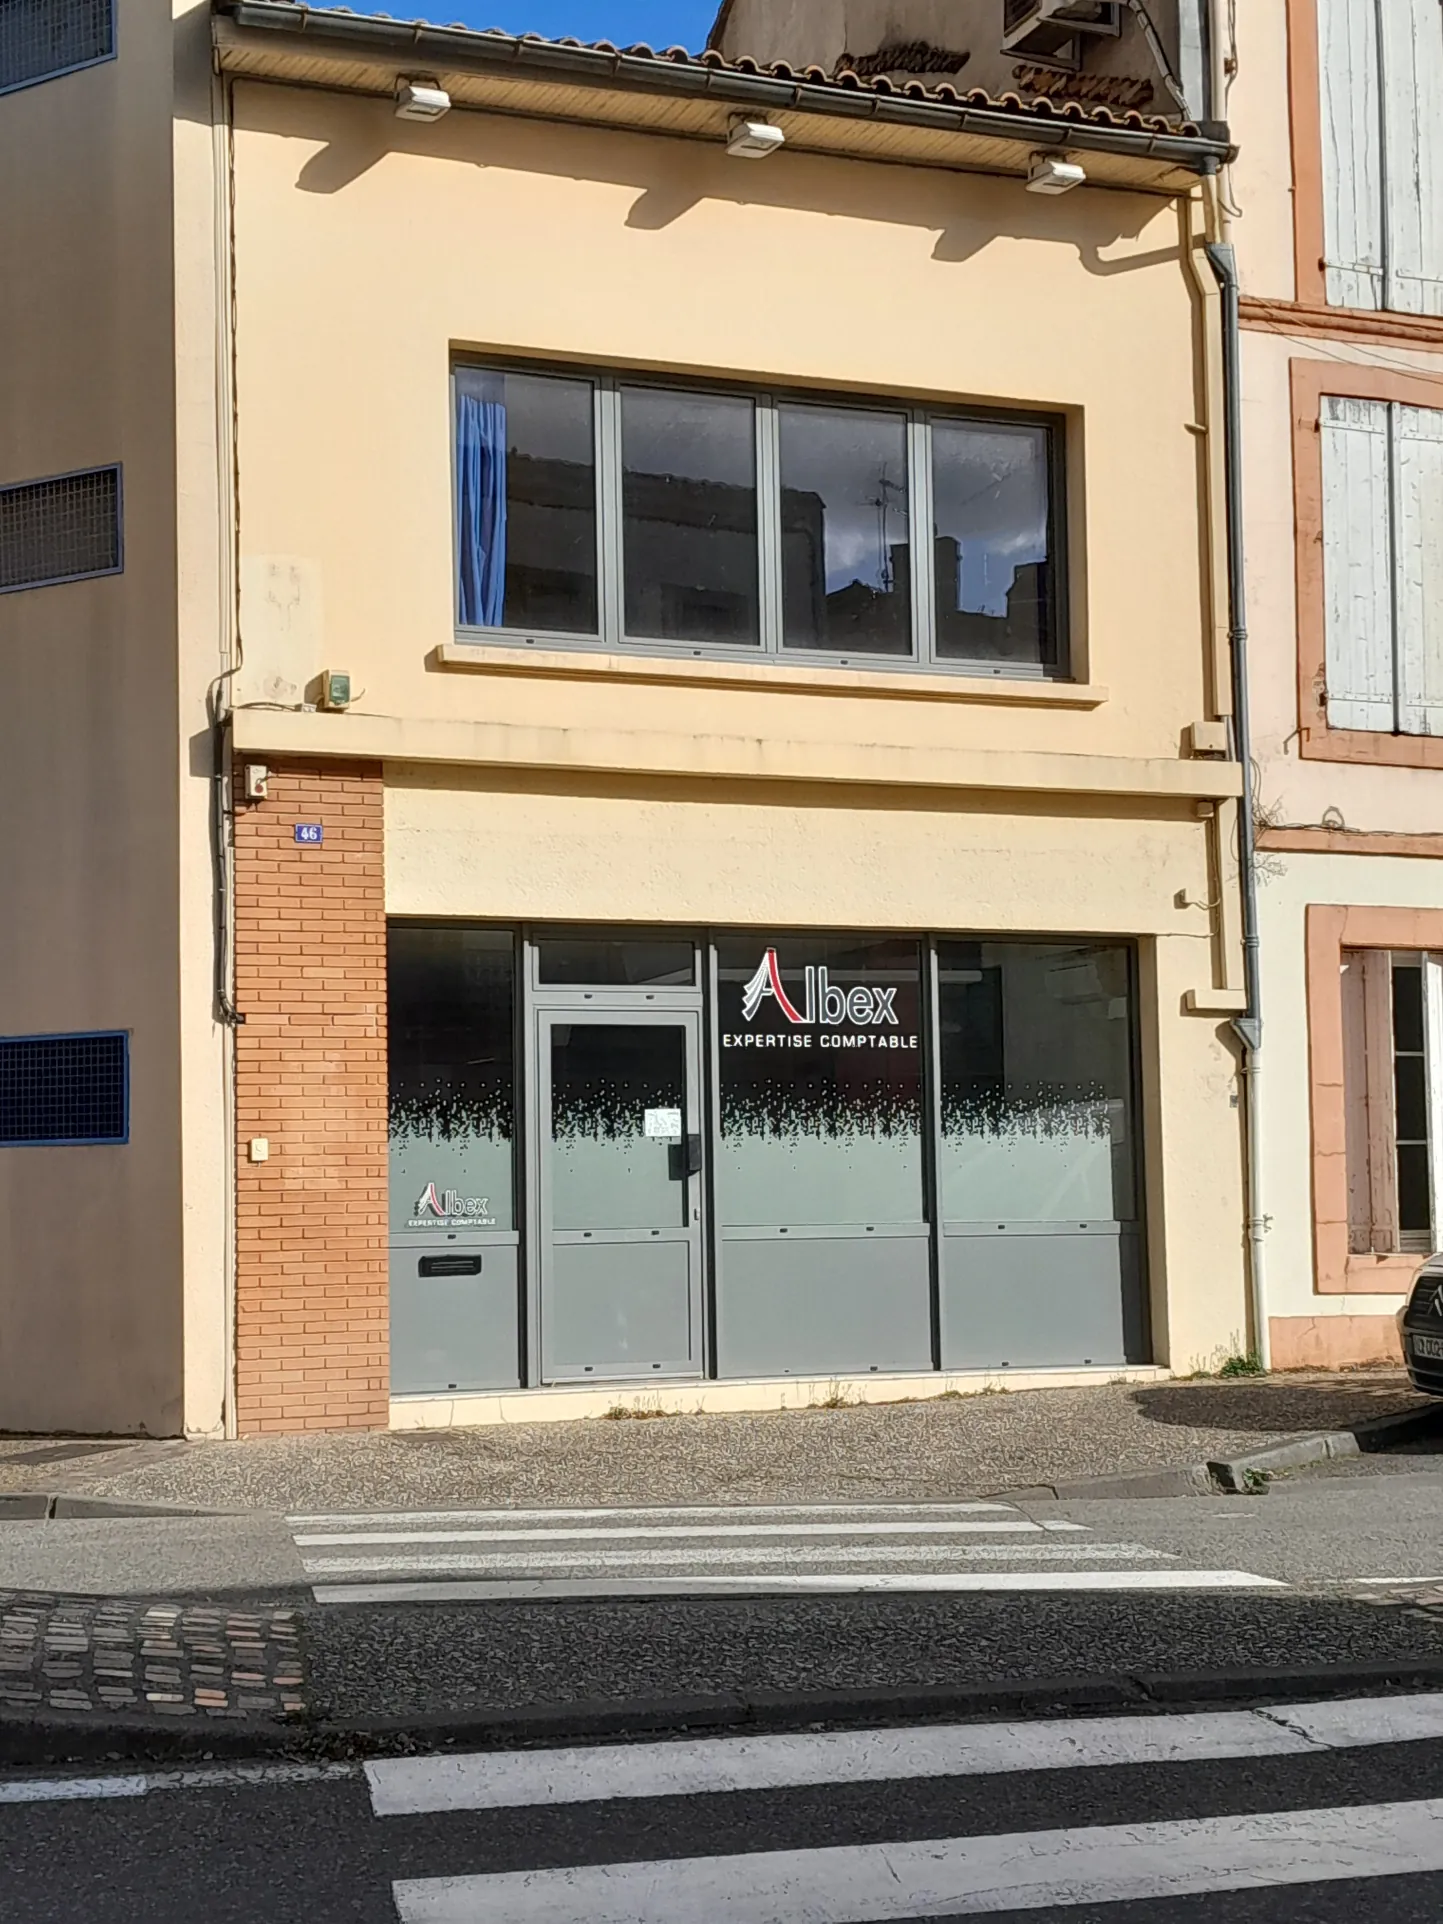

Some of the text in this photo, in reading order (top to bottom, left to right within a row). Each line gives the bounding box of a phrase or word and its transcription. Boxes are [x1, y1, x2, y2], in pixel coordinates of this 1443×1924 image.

[301, 827, 317, 840] 46
[742, 948, 899, 1025] Albex
[723, 1034, 918, 1048] EXPERTISE COMPTABLE
[416, 1182, 489, 1216] Albex
[408, 1218, 496, 1227] EXPERTISE COMPTABLE
